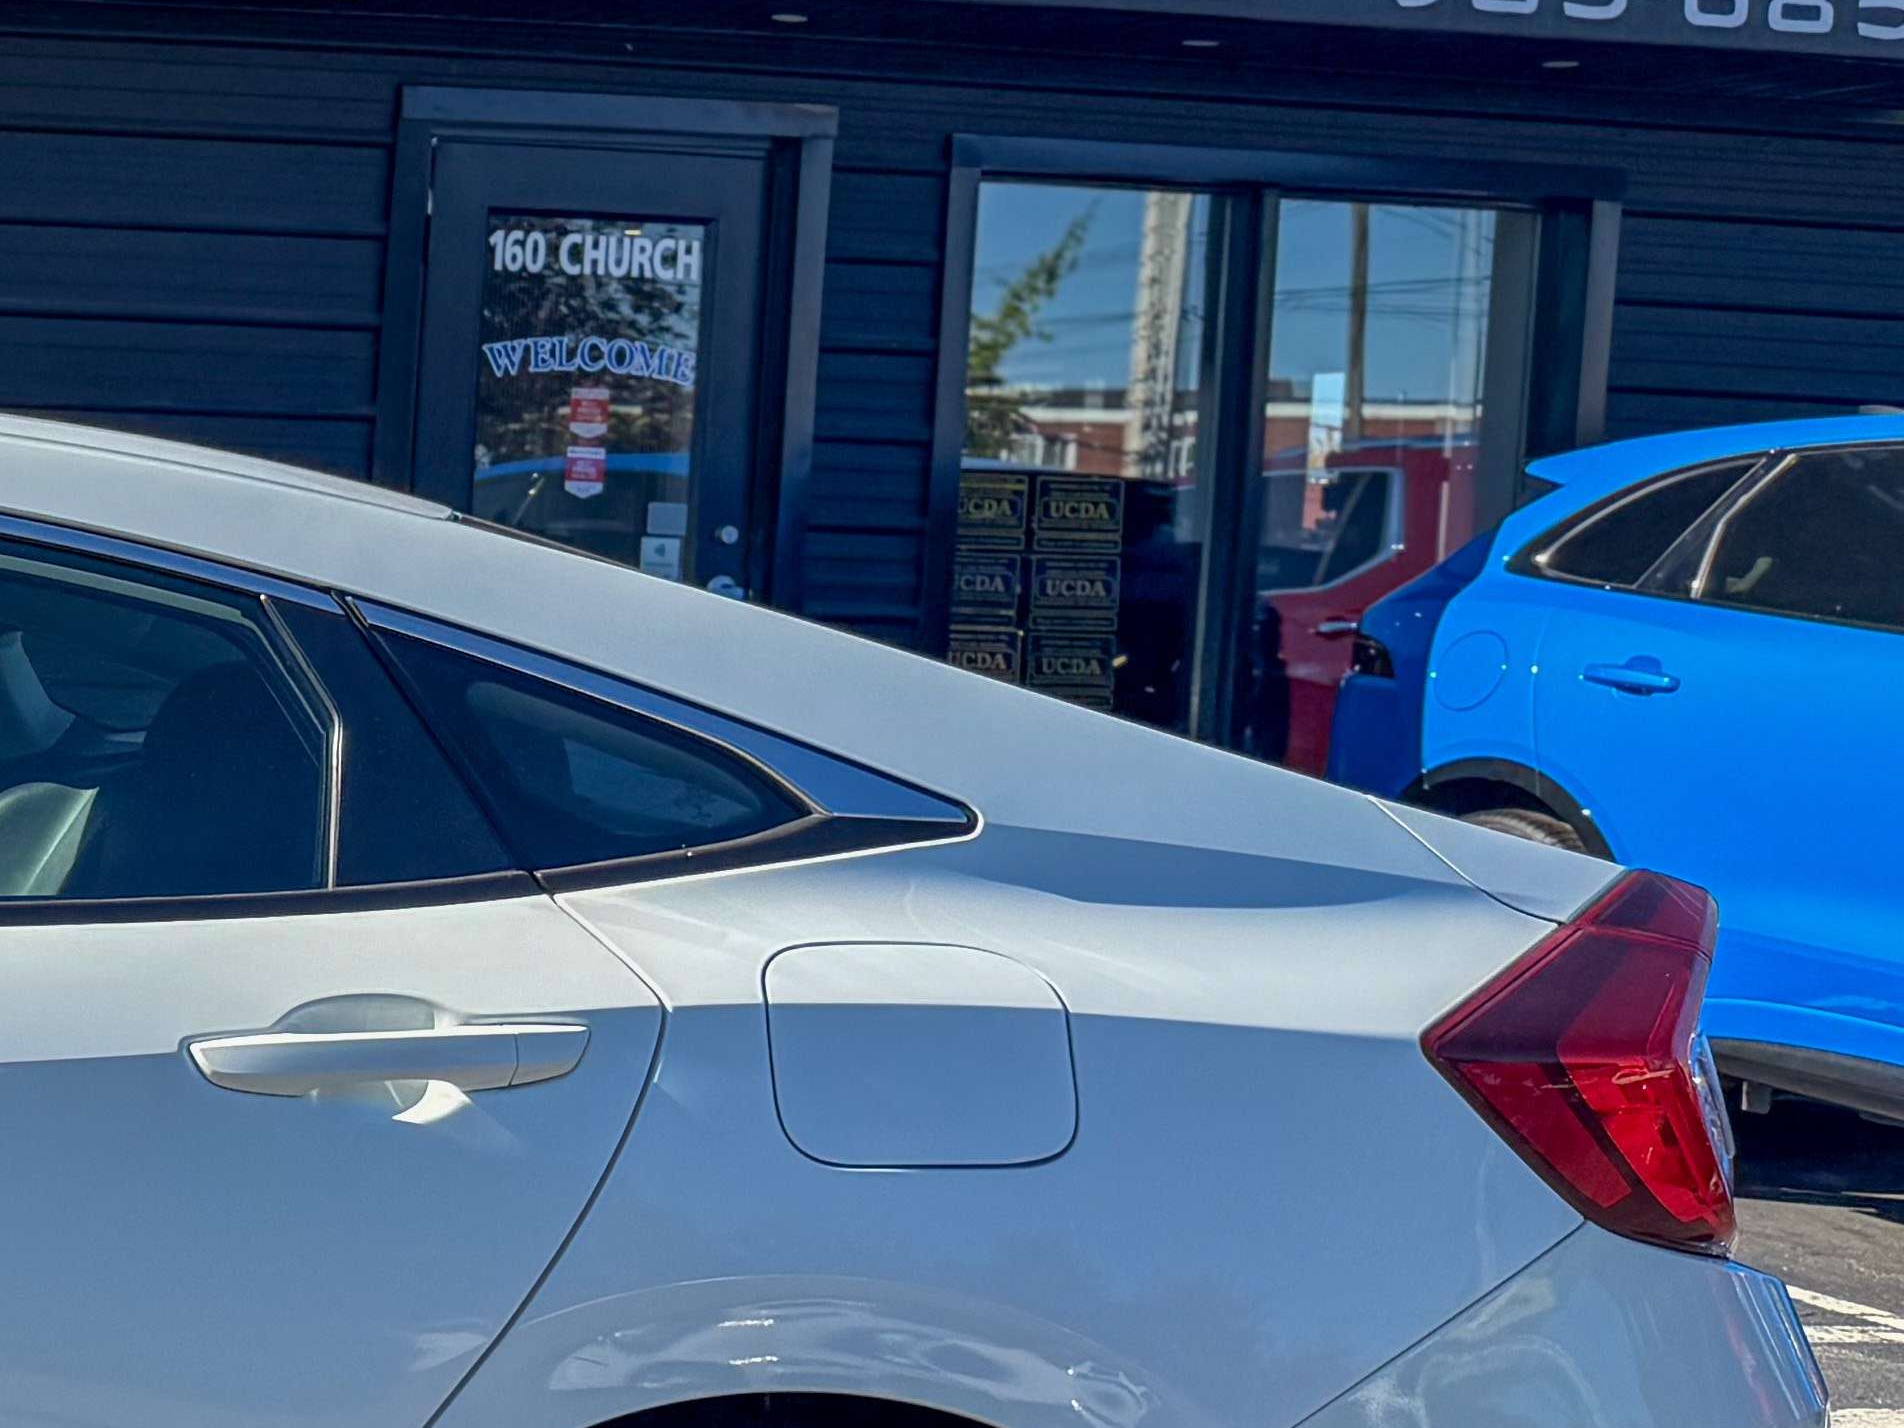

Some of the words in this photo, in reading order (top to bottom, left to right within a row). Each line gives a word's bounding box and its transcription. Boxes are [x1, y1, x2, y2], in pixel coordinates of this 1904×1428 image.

[489, 229, 546, 273] 160
[559, 232, 702, 281] CHURCH
[482, 335, 697, 389] WELCOME
[1049, 500, 1110, 519] UCDA
[1045, 579, 1107, 597] UCDA
[1041, 657, 1102, 676] UCDA
